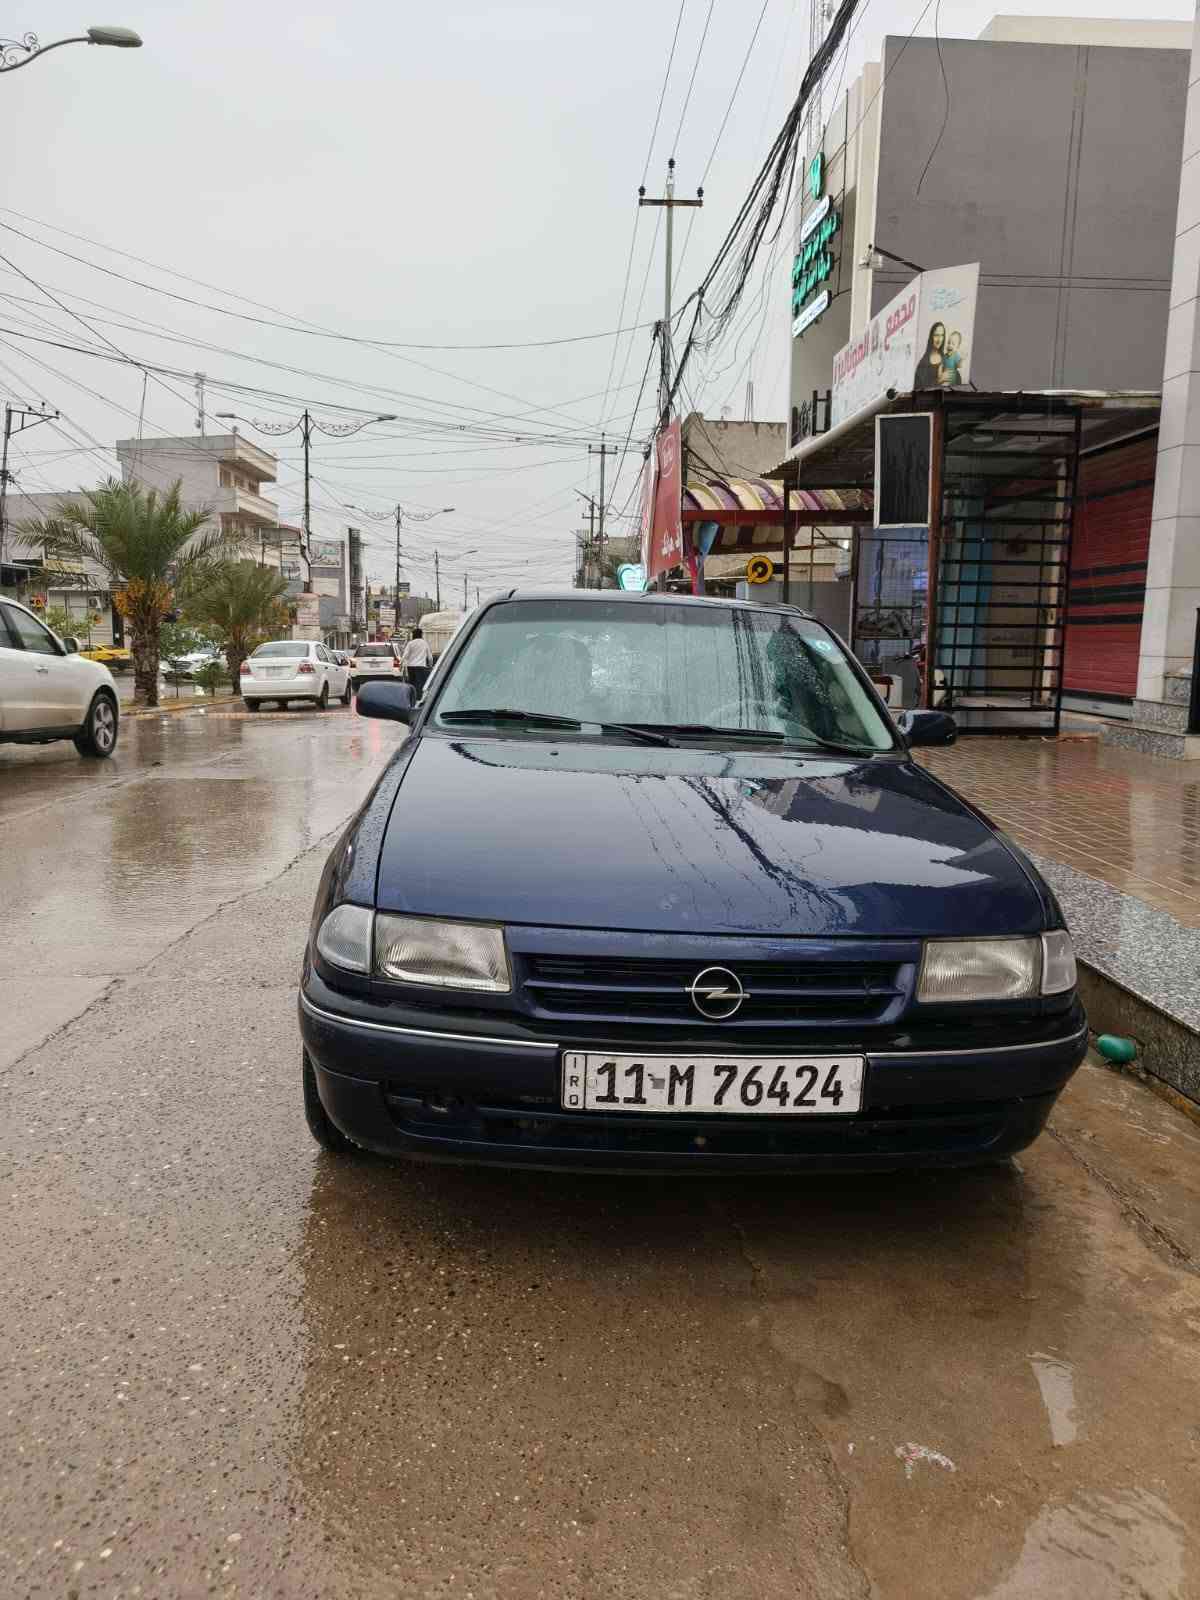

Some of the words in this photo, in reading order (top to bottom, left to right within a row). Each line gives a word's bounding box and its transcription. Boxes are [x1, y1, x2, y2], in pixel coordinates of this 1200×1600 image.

[595, 1062, 647, 1105] 11
[667, 1064, 696, 1106] M
[712, 1064, 845, 1107] 76424
